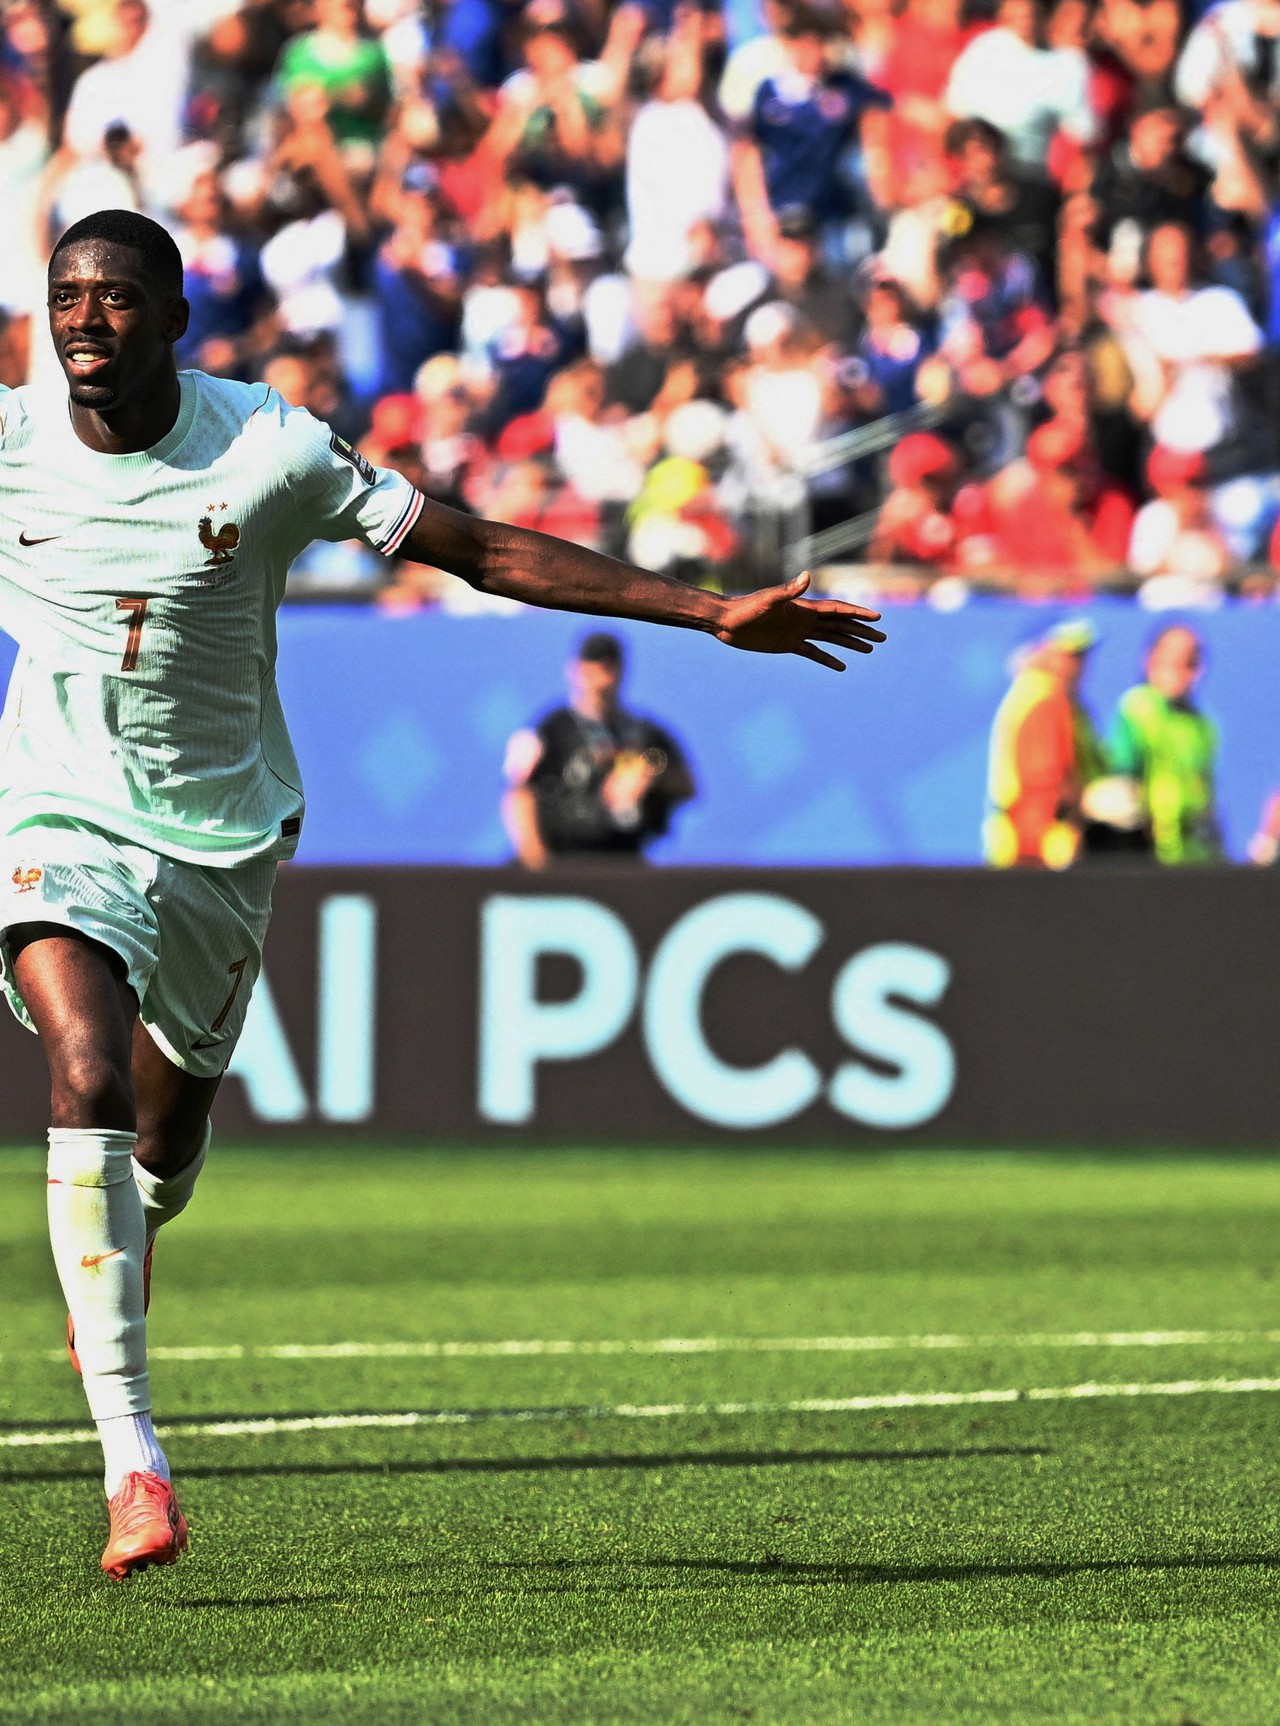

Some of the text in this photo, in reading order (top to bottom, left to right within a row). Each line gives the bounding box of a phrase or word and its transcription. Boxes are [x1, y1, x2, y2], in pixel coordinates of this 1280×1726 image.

[115, 598, 148, 671] 7
[210, 955, 248, 1033] 7
[478, 891, 956, 1129] PCs
